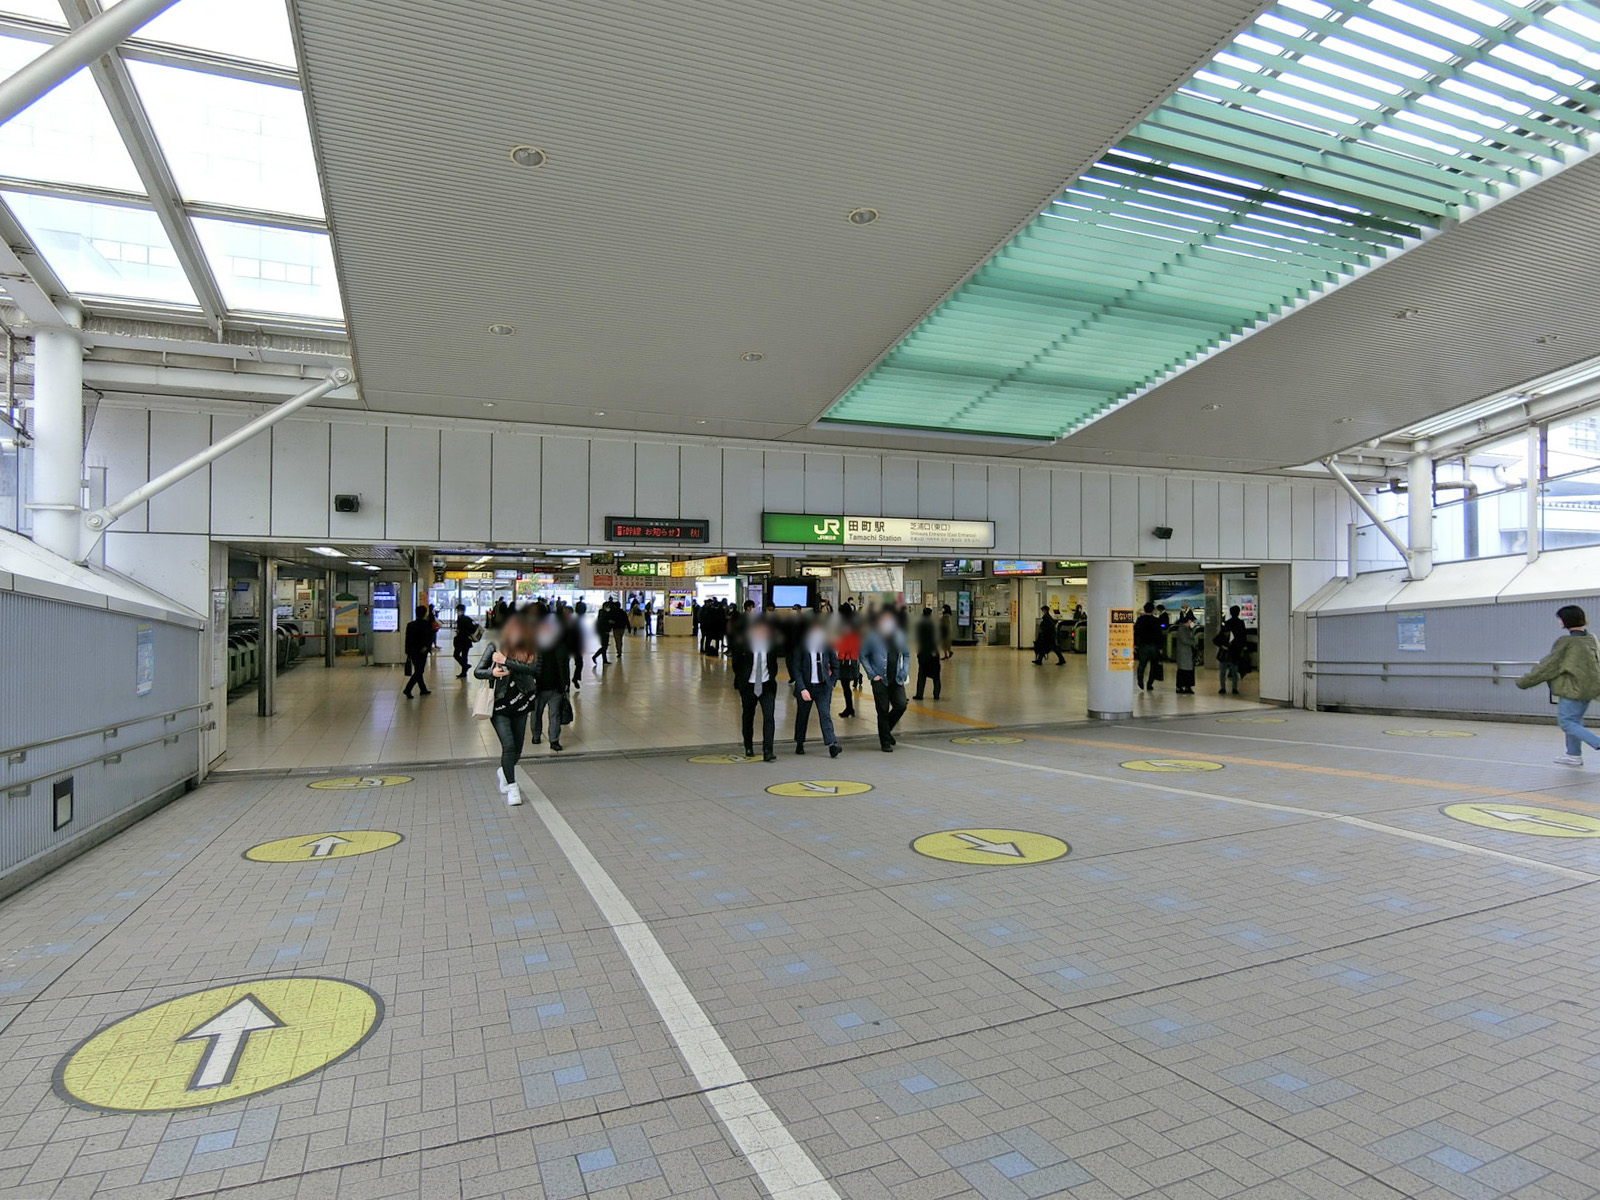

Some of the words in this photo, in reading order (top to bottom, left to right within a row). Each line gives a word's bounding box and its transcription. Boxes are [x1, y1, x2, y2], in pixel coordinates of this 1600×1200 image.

[814, 519, 840, 535] JR
[848, 520, 885, 532] 田町駅
[878, 534, 902, 542] Station
